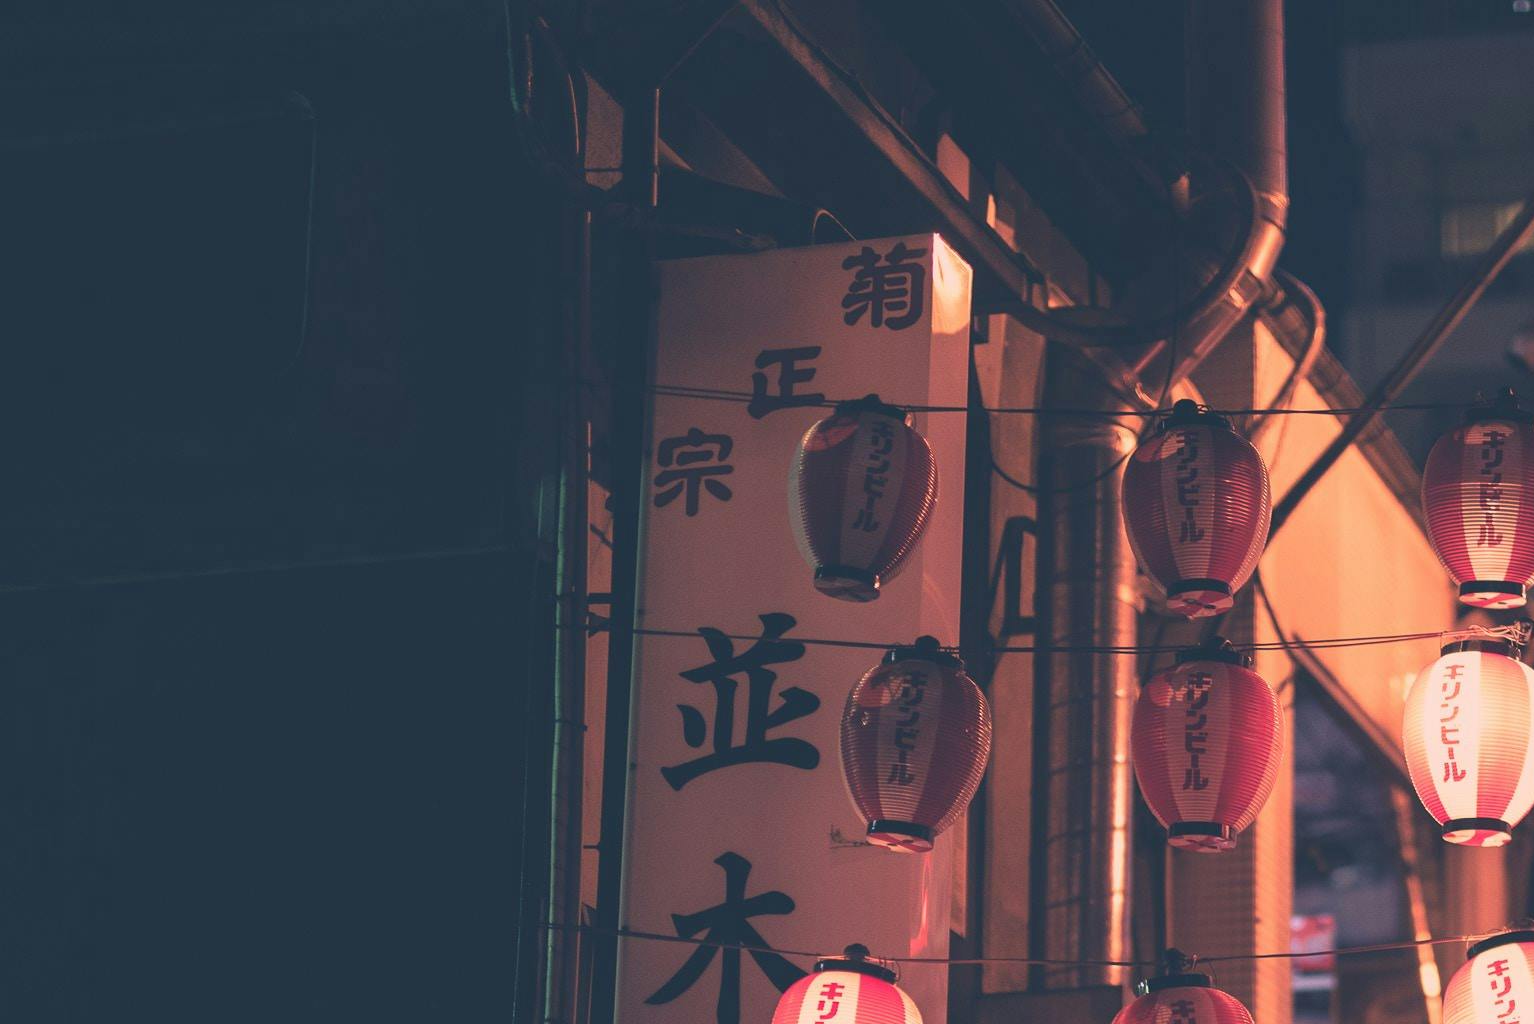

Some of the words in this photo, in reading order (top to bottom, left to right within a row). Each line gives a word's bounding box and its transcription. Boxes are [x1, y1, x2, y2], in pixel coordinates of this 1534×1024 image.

[852, 420, 888, 532] キリンビール
[1175, 431, 1204, 543] キリンビール
[888, 672, 928, 785] キリンビール
[1182, 672, 1212, 791] キリンビール
